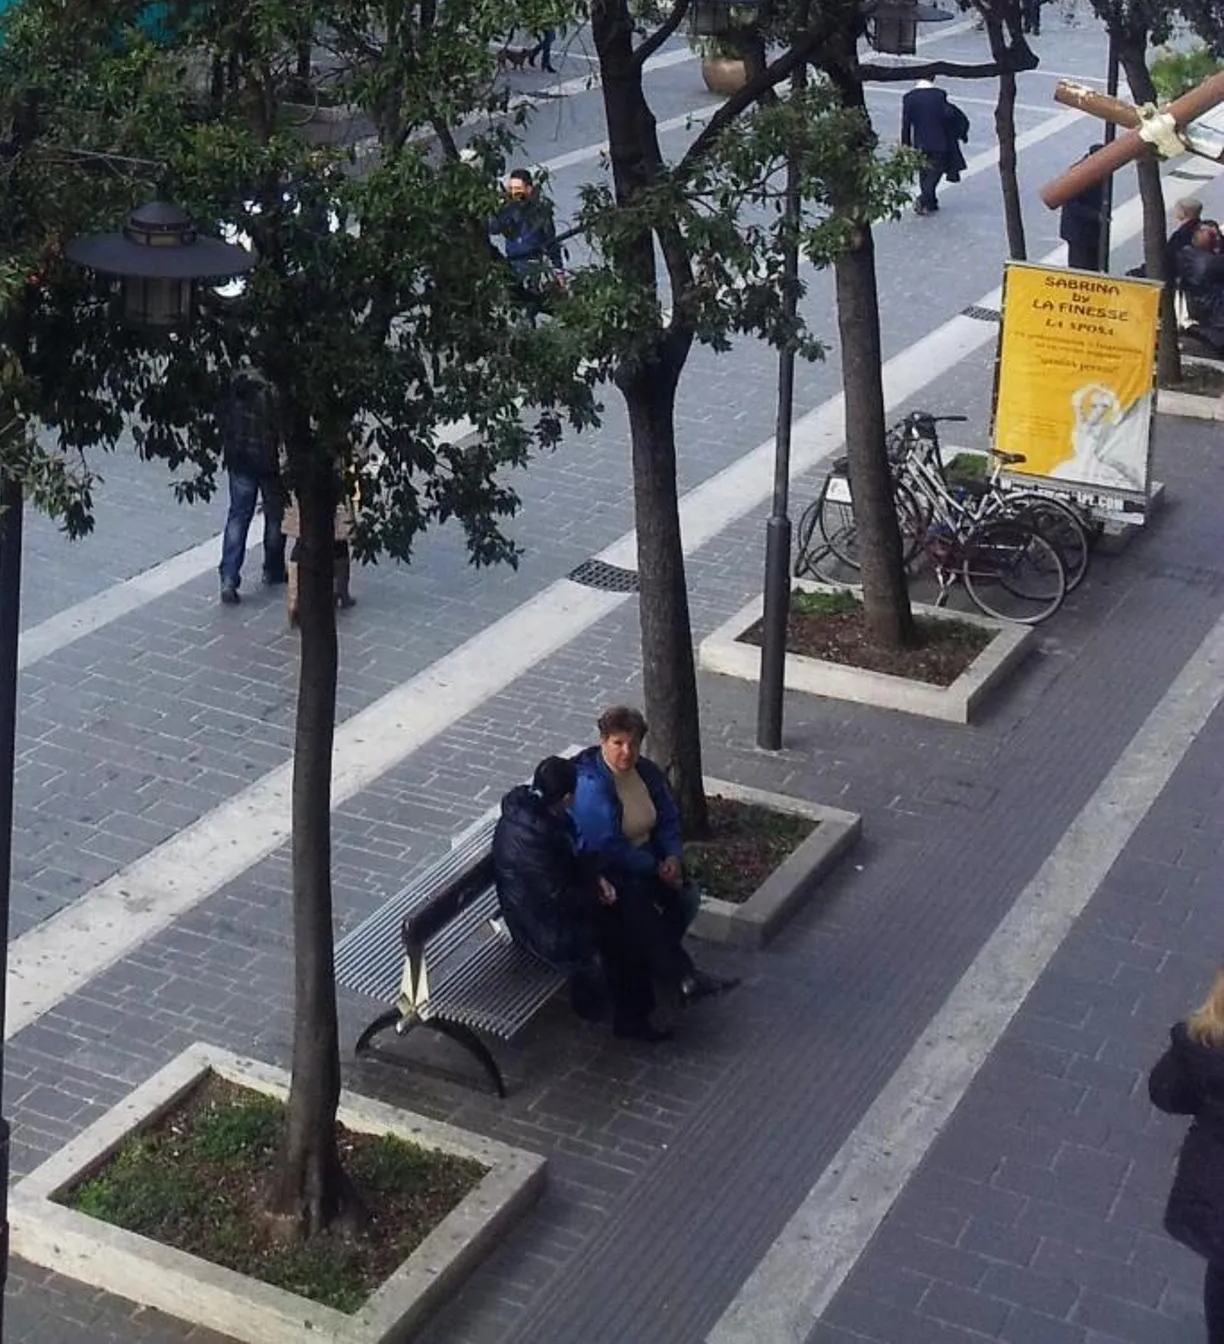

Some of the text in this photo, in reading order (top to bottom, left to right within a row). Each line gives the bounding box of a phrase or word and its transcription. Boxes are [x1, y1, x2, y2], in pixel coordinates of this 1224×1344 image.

[1045, 275, 1119, 296] SABRINA
[1072, 292, 1090, 303] by
[1032, 298, 1129, 322] LA FINESSE
